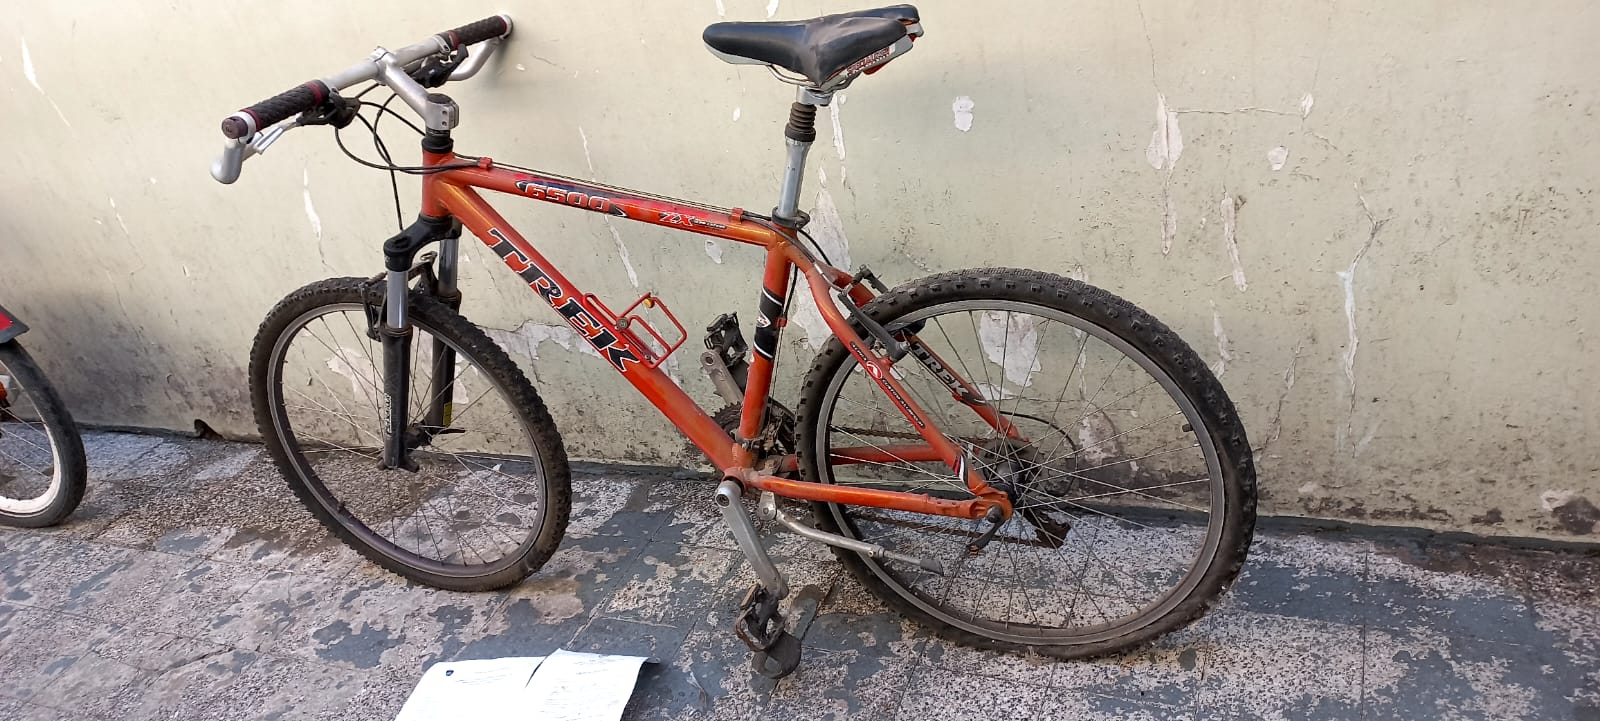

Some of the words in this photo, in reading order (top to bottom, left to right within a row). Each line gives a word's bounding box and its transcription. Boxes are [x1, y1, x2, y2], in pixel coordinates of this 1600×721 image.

[525, 183, 611, 211] 6500
[487, 227, 641, 373] TREK
[912, 342, 970, 399] TREK
